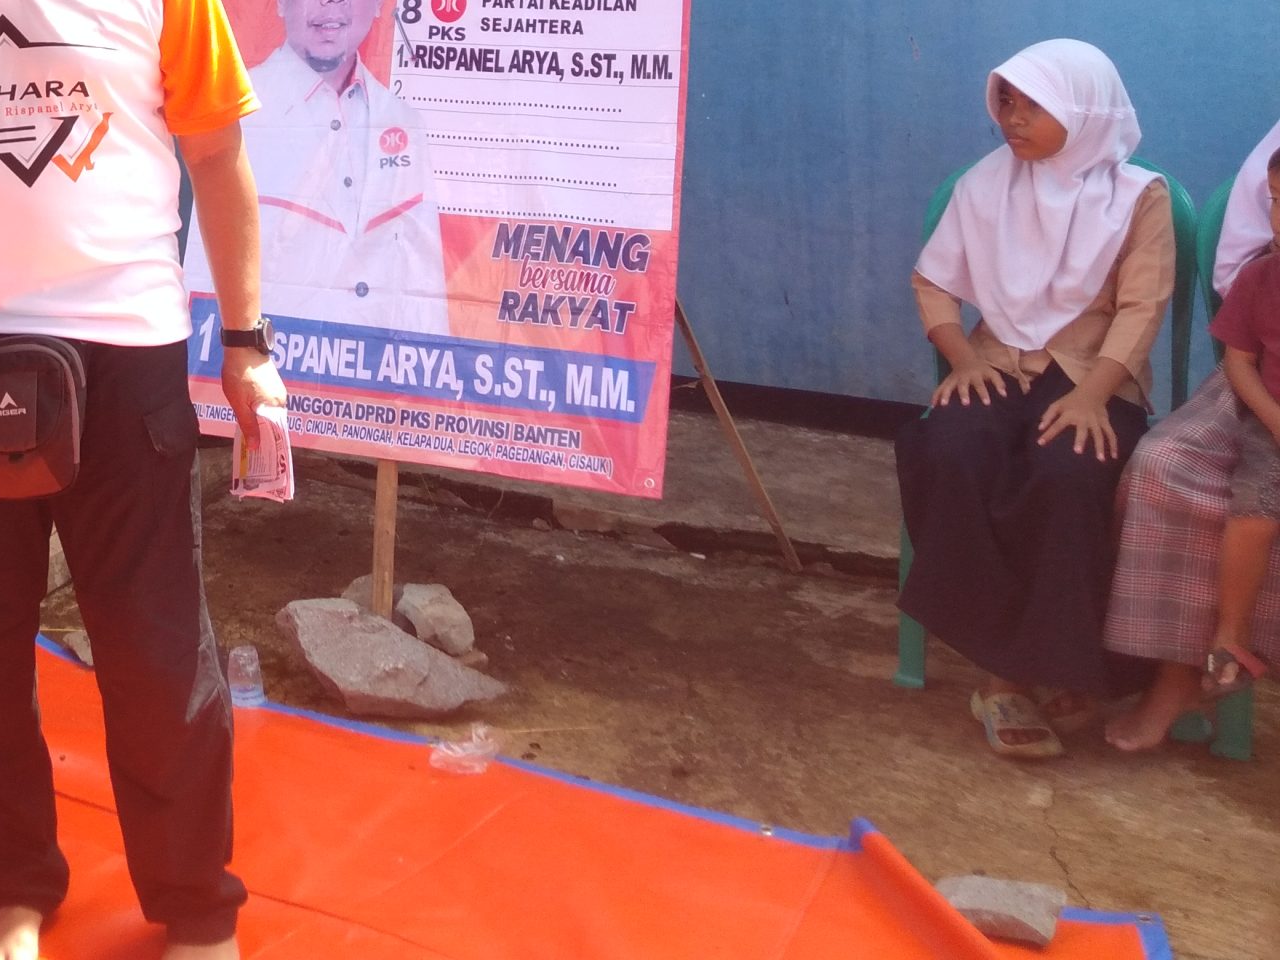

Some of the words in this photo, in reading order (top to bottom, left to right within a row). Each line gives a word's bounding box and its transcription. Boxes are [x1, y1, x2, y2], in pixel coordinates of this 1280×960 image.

[428, 25, 466, 41] PKS
[480, 17, 584, 35] SEJAHTERA
[414, 45, 504, 73] RISPANEL
[508, 50, 565, 81] ARYA,
[570, 52, 624, 84] S.ST.,
[630, 53, 673, 80] M.M.
[6, 102, 64, 117] Rispanel
[379, 155, 411, 169] PKS
[491, 221, 651, 272] MENANG
[519, 254, 616, 295] bersama
[497, 290, 636, 334] RAKYAT
[270, 331, 371, 381] SPANEL
[376, 343, 464, 401] ARYA,
[473, 353, 556, 412] S.ST.,
[565, 363, 635, 413] M.M.
[286, 393, 352, 420] ANGGOTA
[355, 405, 395, 424] DPRD
[400, 409, 431, 429] PKS
[435, 413, 509, 440] PROVINSI
[513, 425, 580, 449] BANTEN
[306, 420, 339, 438] CIKUPA,
[341, 425, 394, 446] PANONGAN,
[397, 430, 432, 448] KELAPA
[433, 438, 455, 454] DUA,
[458, 440, 492, 458] LEGOK,
[495, 445, 566, 468] PAGEDANGAN,
